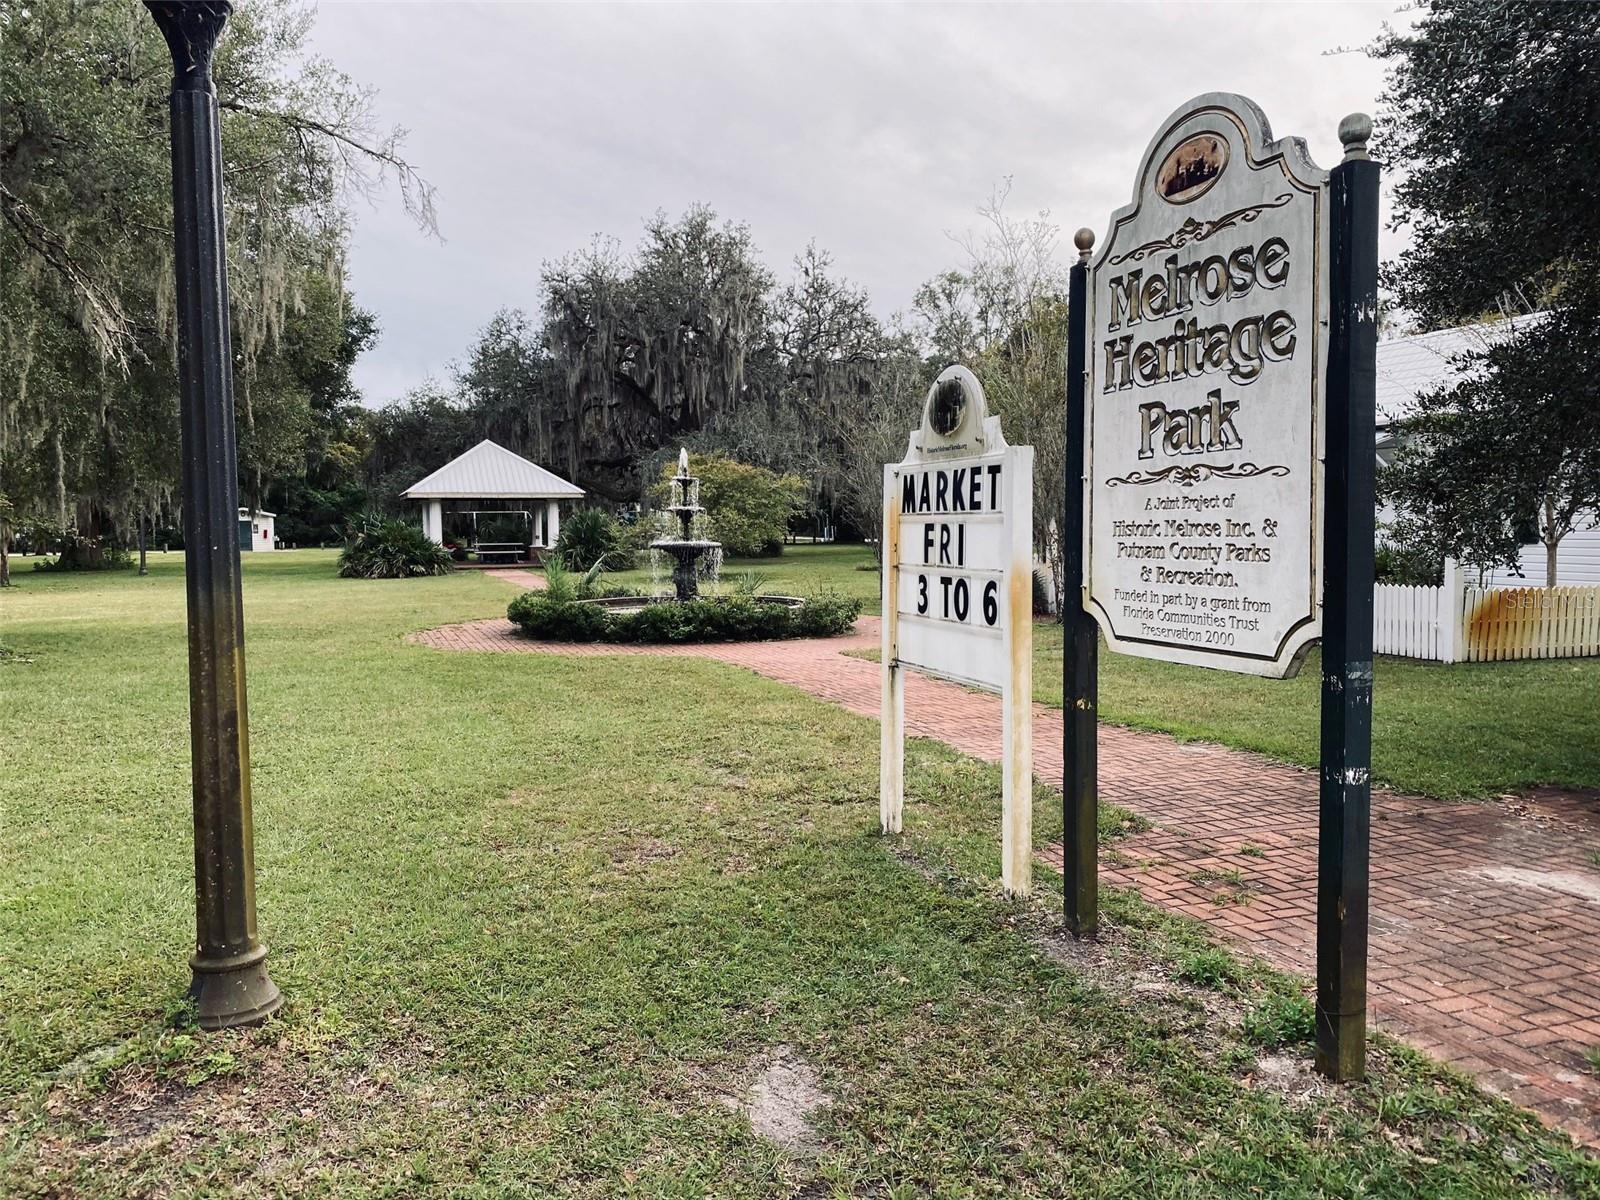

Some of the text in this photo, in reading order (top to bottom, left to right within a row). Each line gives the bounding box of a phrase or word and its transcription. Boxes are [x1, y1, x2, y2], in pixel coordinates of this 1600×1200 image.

[1108, 236, 1290, 332] Melrose
[1103, 309, 1297, 394] Heritage
[1137, 388, 1243, 460] Park
[902, 464, 1002, 513] MARKET
[1145, 493, 1236, 512] A Joint Project of
[1112, 519, 1161, 537] Historic
[1164, 519, 1221, 537] Melrose
[1262, 518, 1278, 538] &
[923, 523, 964, 567] FRI
[1117, 541, 1271, 565] Putnam County Parks
[1140, 565, 1239, 588] & Recreation.
[917, 574, 998, 626] 3 TO 6
[1114, 588, 1271, 613] Funded in part by a grant from
[1123, 605, 1260, 632] Florida Communities Trust
[1141, 622, 1235, 646] Preservation 2000
